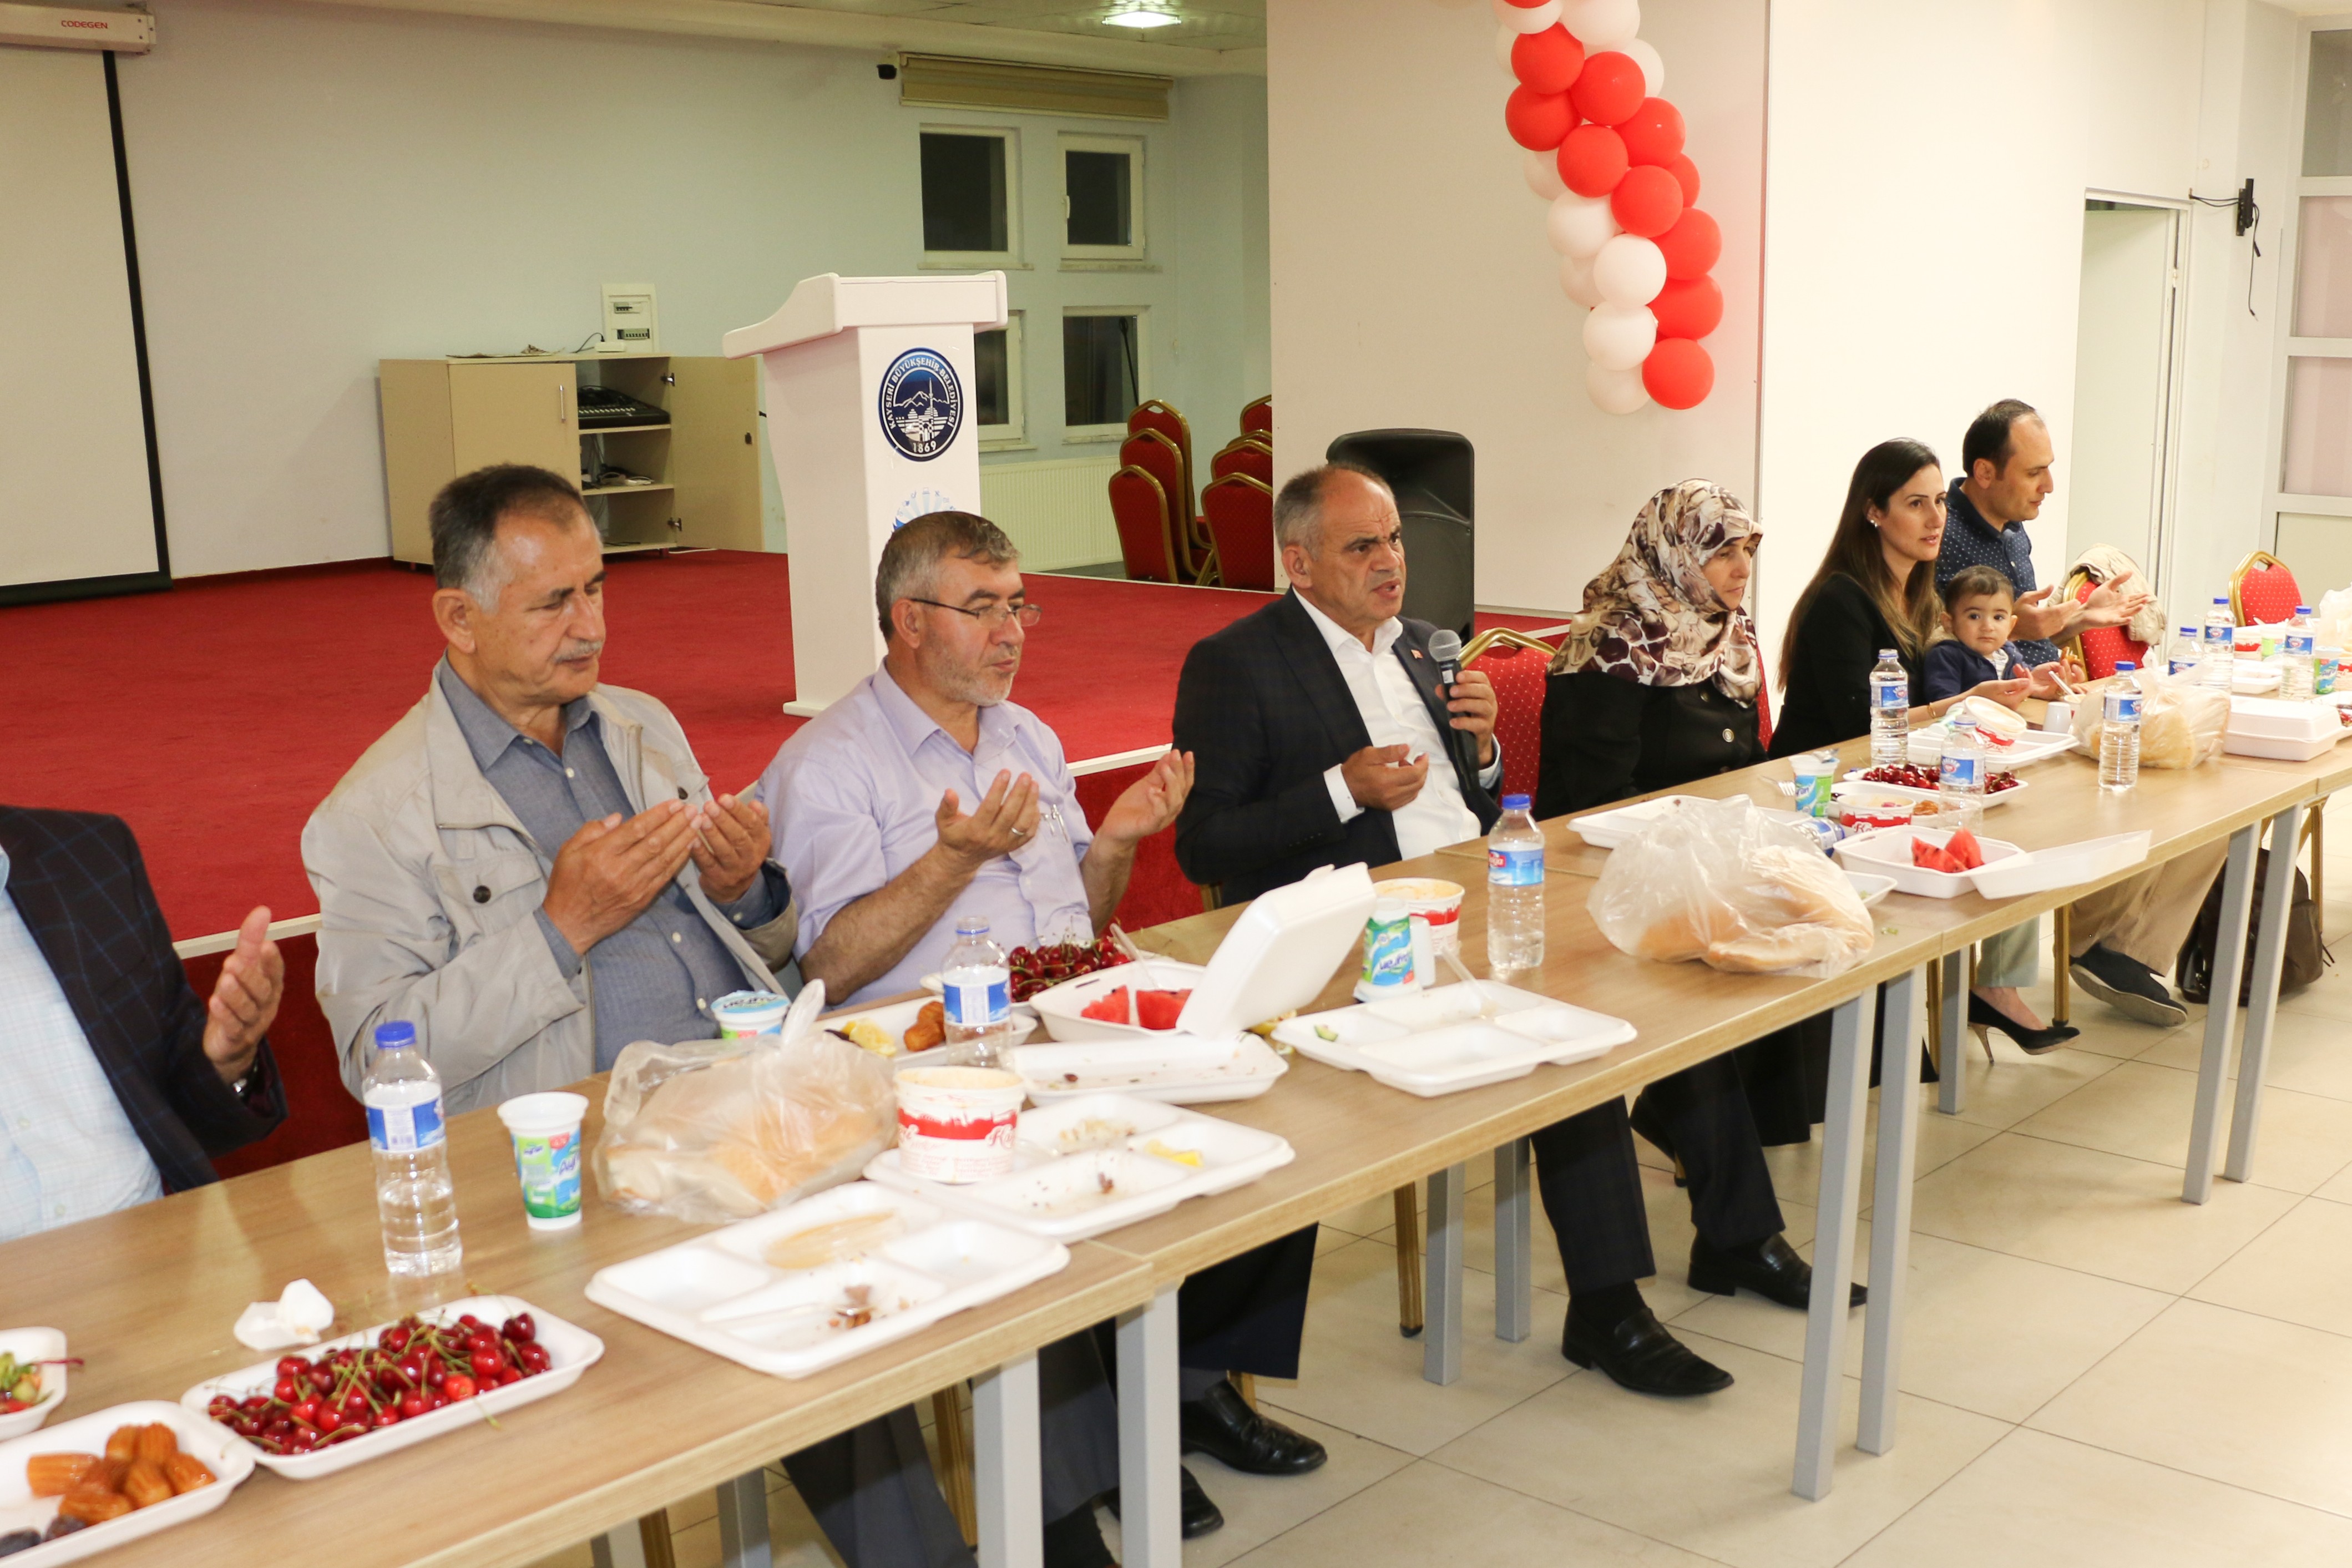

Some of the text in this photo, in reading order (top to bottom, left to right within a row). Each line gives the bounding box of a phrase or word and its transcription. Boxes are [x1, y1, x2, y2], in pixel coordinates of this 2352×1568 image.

[61, 20, 108, 29] CODEGEN
[886, 357, 958, 429] KAYSERİ BÜYÜKŞEHİR BELEDİYESİ
[914, 441, 937, 453] 1869
